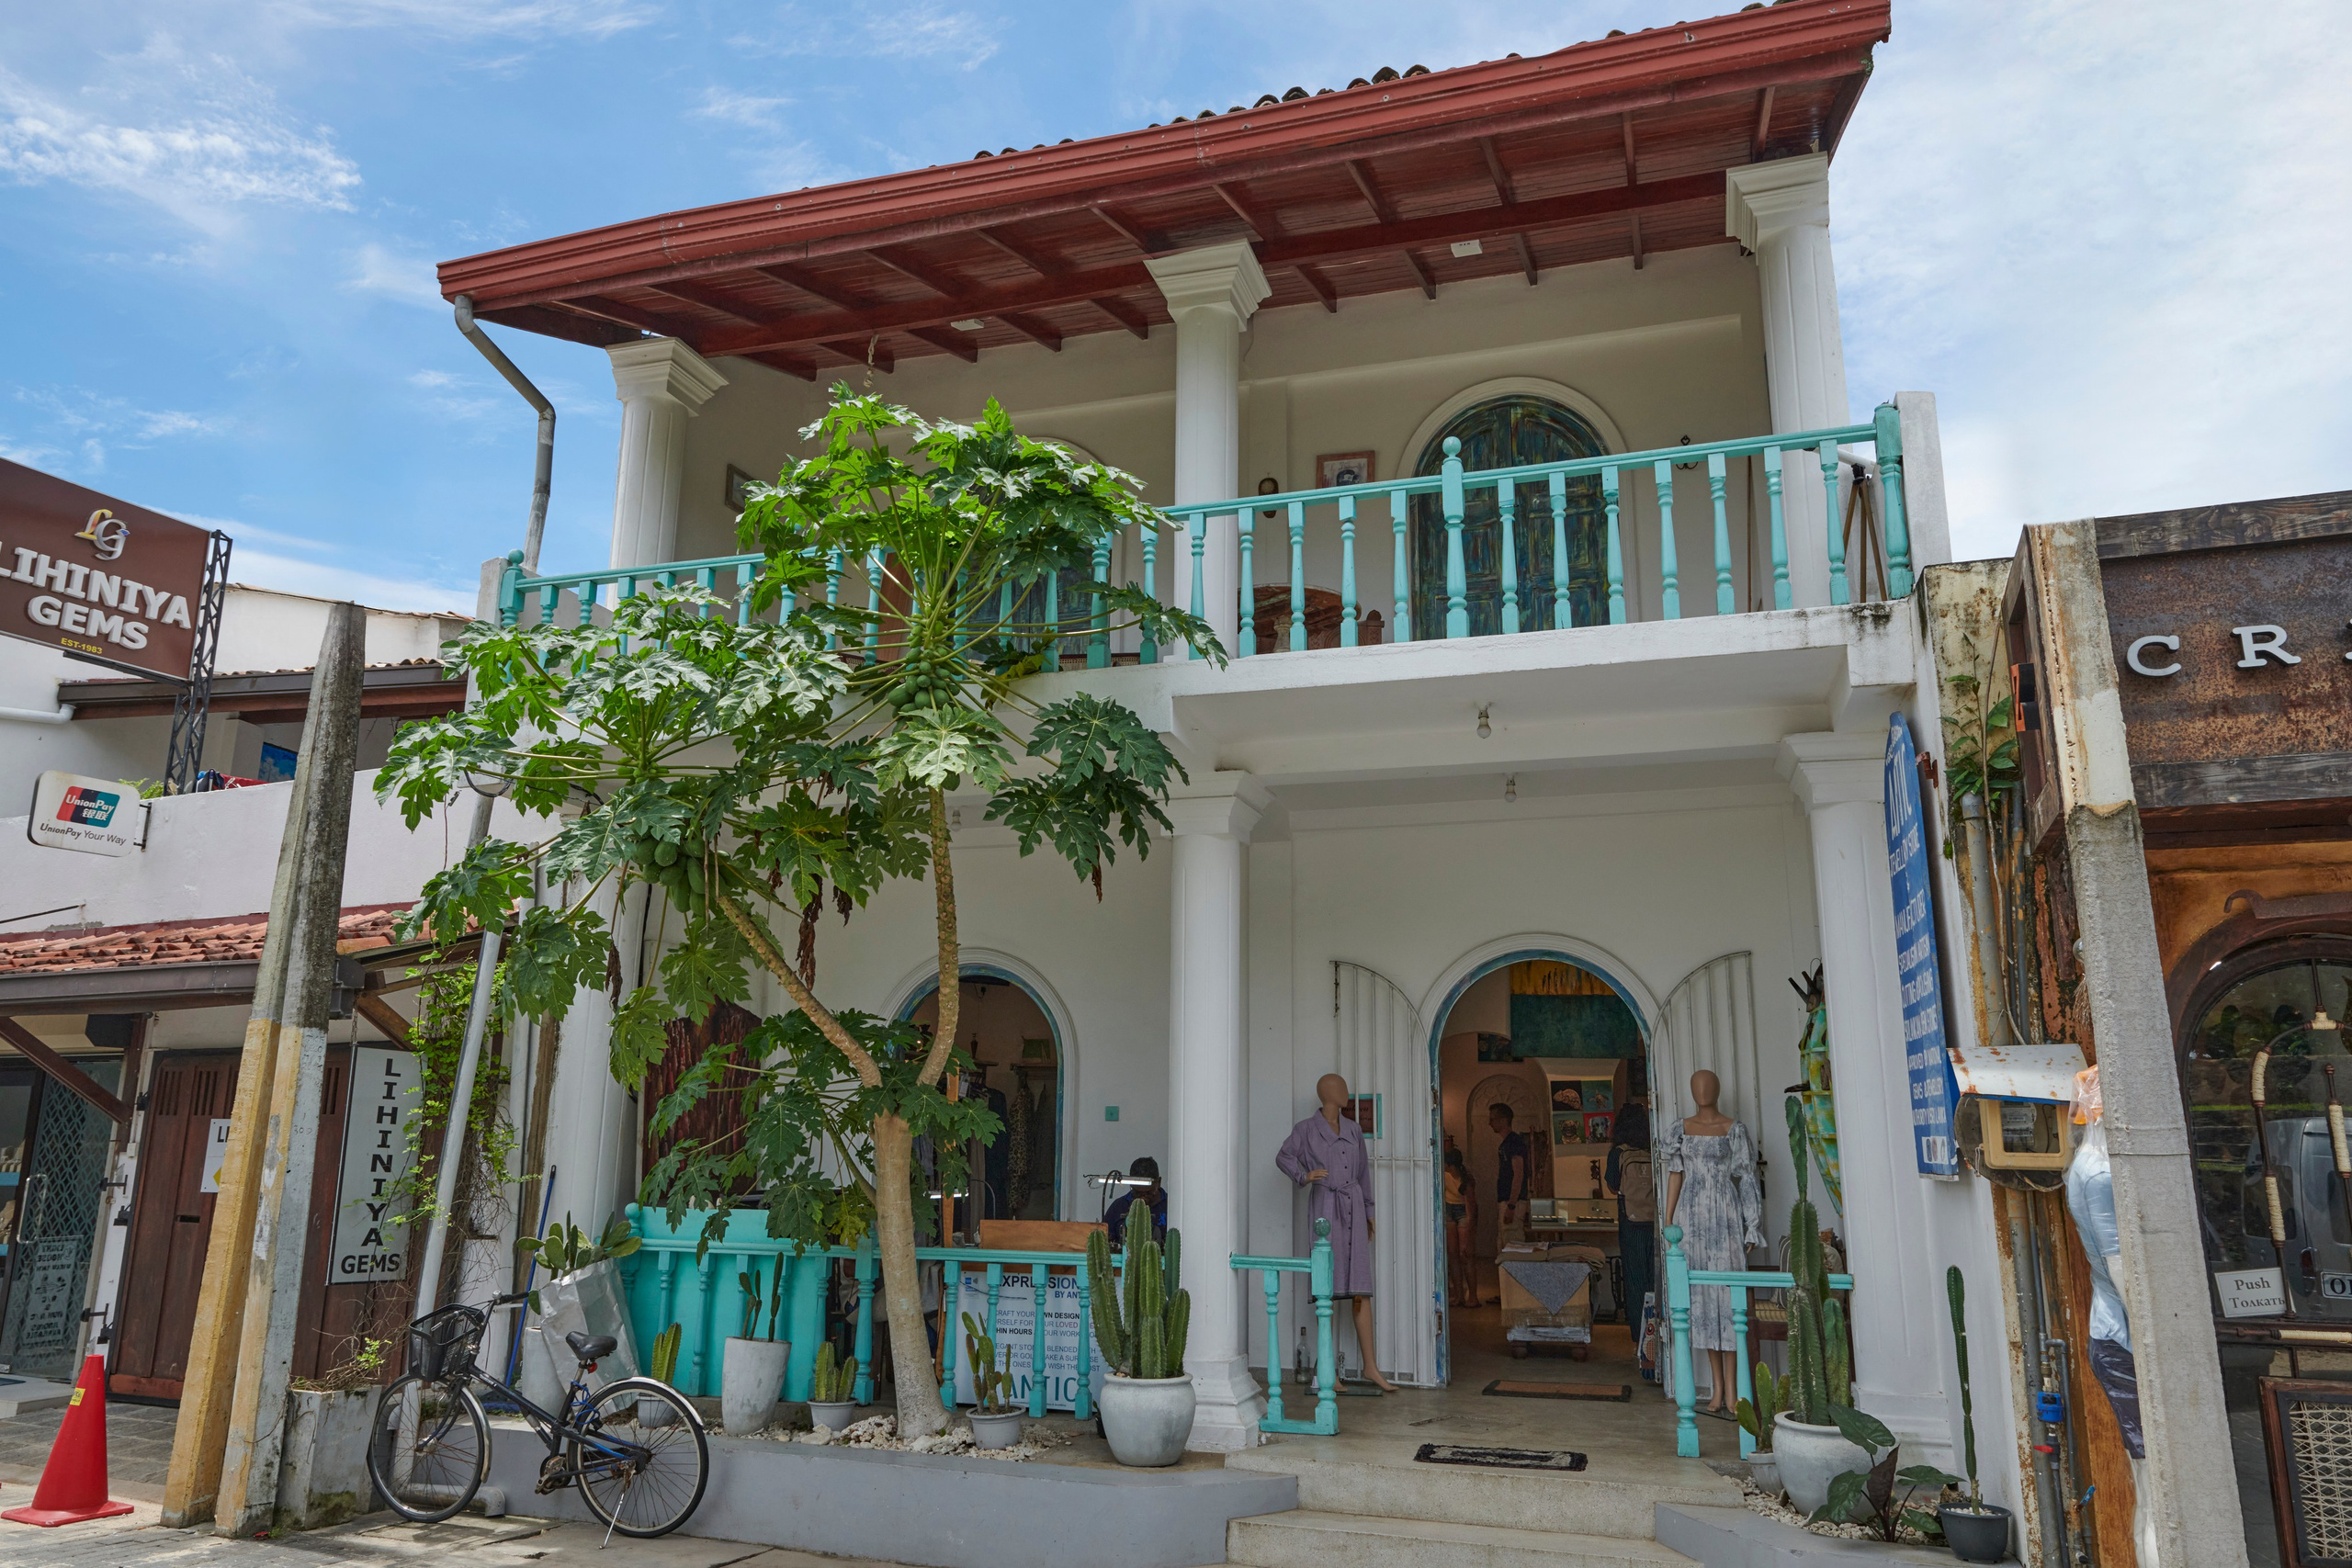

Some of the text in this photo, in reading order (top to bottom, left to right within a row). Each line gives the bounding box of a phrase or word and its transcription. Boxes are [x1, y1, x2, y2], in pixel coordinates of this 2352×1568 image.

[28, 595, 150, 649] GEMS
[61, 637, 103, 654] EST-1983
[2127, 618, 2352, 677] CR
[65, 795, 115, 814] UnionPay
[82, 808, 109, 820] 银联
[40, 822, 126, 846] UnionPay Your Way
[361, 1058, 401, 1247] LIHINIYA
[341, 1254, 401, 1275] GEMS
[1000, 1275, 1080, 1290] XPRSION
[2234, 1277, 2271, 1291] Push
[1067, 1291, 1080, 1299] ANT
[2229, 1297, 2285, 1309] Толкать
